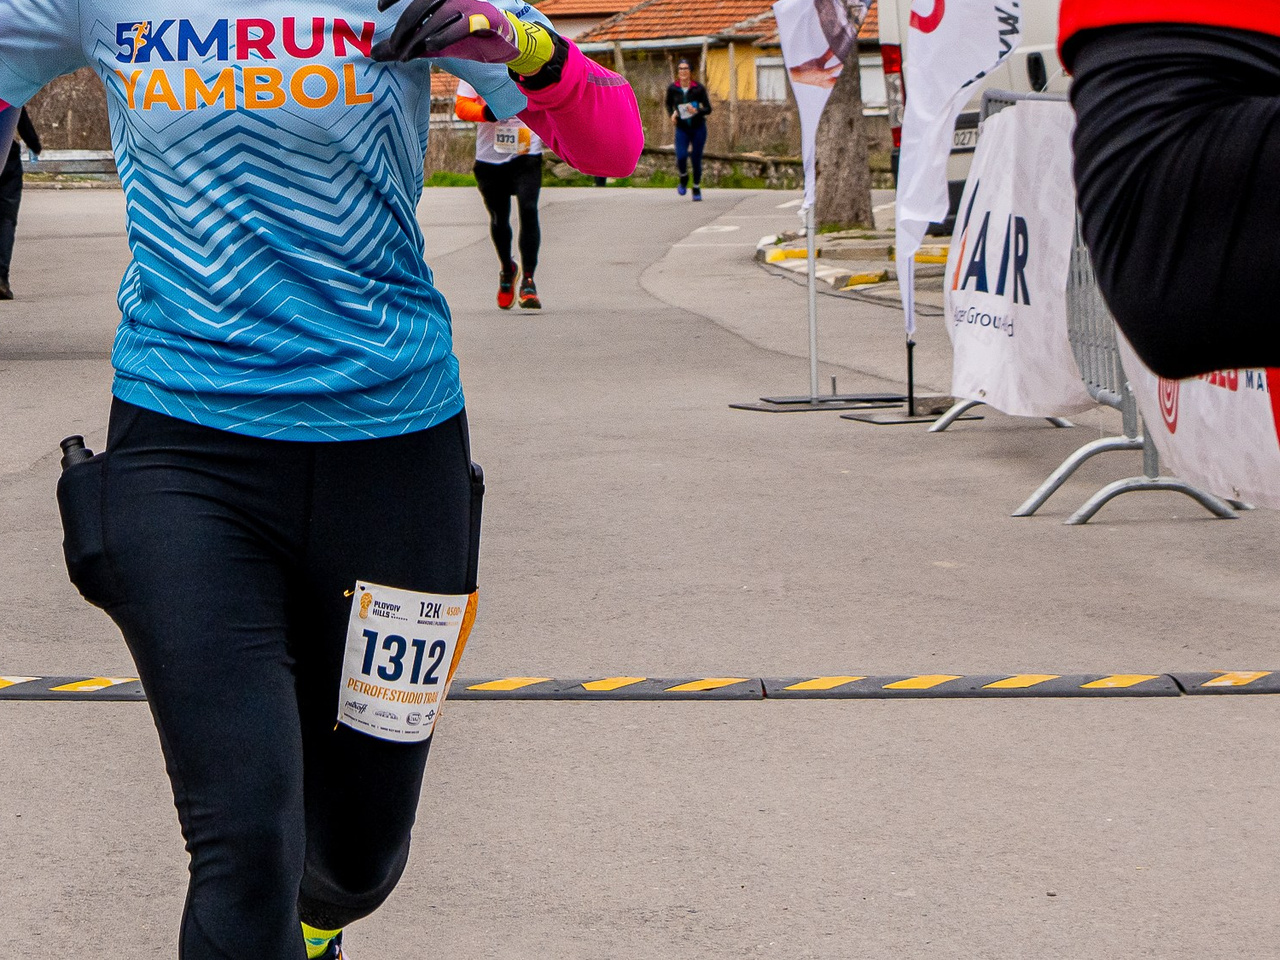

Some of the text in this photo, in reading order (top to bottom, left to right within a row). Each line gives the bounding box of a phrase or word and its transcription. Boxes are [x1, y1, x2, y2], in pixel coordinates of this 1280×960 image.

[114, 17, 376, 64] 5KMRUN
[114, 63, 374, 111] YAMBOL
[1245, 369, 1269, 393] MA
[372, 608, 390, 619] HILLS
[373, 600, 401, 613] PLOVDIV
[361, 628, 447, 685] 1312
